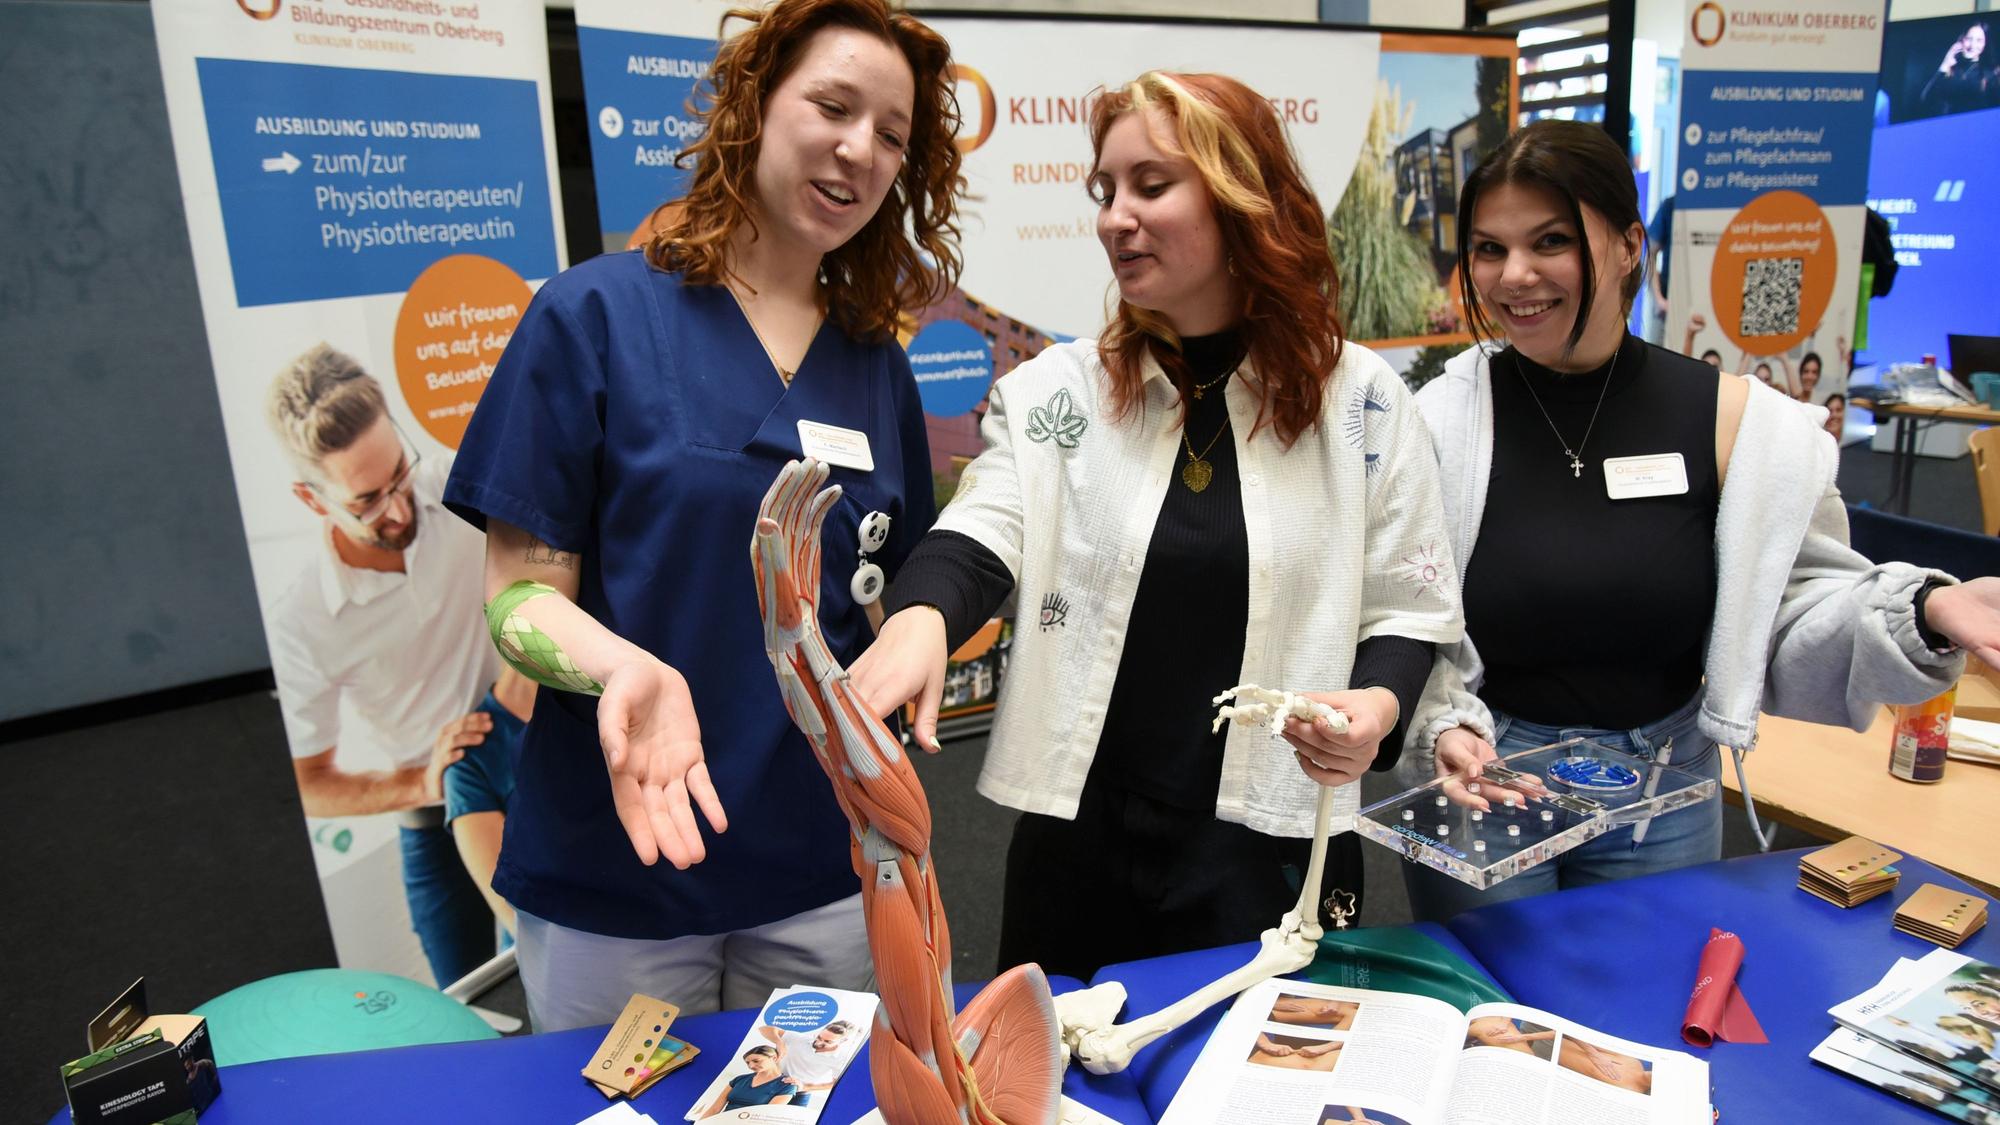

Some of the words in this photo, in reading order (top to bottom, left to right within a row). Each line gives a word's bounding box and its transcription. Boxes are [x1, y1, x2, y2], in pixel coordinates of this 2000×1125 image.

[451, 4, 479, 20] und
[1730, 11, 1799, 27] KLINIKUM
[1803, 13, 1877, 30] OBERBERG
[291, 5, 430, 36] Bildungszentrum
[434, 21, 505, 47] Oberberg
[294, 32, 353, 48] KLINIKUM
[357, 38, 415, 54] OBERBERG
[1711, 86, 1784, 101] AUSBILDUNG
[1785, 87, 1812, 102] UND
[1813, 87, 1864, 102] STUDIUM
[1009, 96, 1094, 124] KLINI
[255, 116, 367, 138] AUSBILDUNG
[371, 120, 408, 138] UND
[411, 121, 481, 140] STUDIUM
[631, 118, 660, 136] zur
[663, 115, 706, 141] Ope
[1706, 131, 1728, 145] zur
[1730, 126, 1825, 147] Pflegefachfrau/
[311, 146, 407, 177] zum/zur
[1705, 152, 1732, 165] zum
[1735, 148, 1832, 168] Pflegefachmann
[1012, 162, 1093, 184] RUNDU
[1704, 175, 1724, 189] zur
[1727, 170, 1820, 191] Pflegeassistenz
[315, 181, 524, 217] Physiotherapeuten/
[321, 216, 515, 253] Physiotherapeutin
[1016, 217, 1096, 241] www.kl
[1751, 219, 1783, 237] freuen
[1786, 222, 1803, 233] uns
[459, 302, 518, 330] freuen
[416, 342, 449, 361] uns
[450, 330, 480, 357] auf
[482, 328, 512, 351] dei
[425, 361, 496, 391] Bewerb
[914, 366, 989, 383] ummersbach
[115, 1043, 132, 1053] EXTRA
[132, 1034, 154, 1046] STRONG
[100, 1088, 146, 1110] KINESIOLOGY
[147, 1081, 165, 1091] TAPE
[101, 1095, 146, 1116] WATERPROOFED
